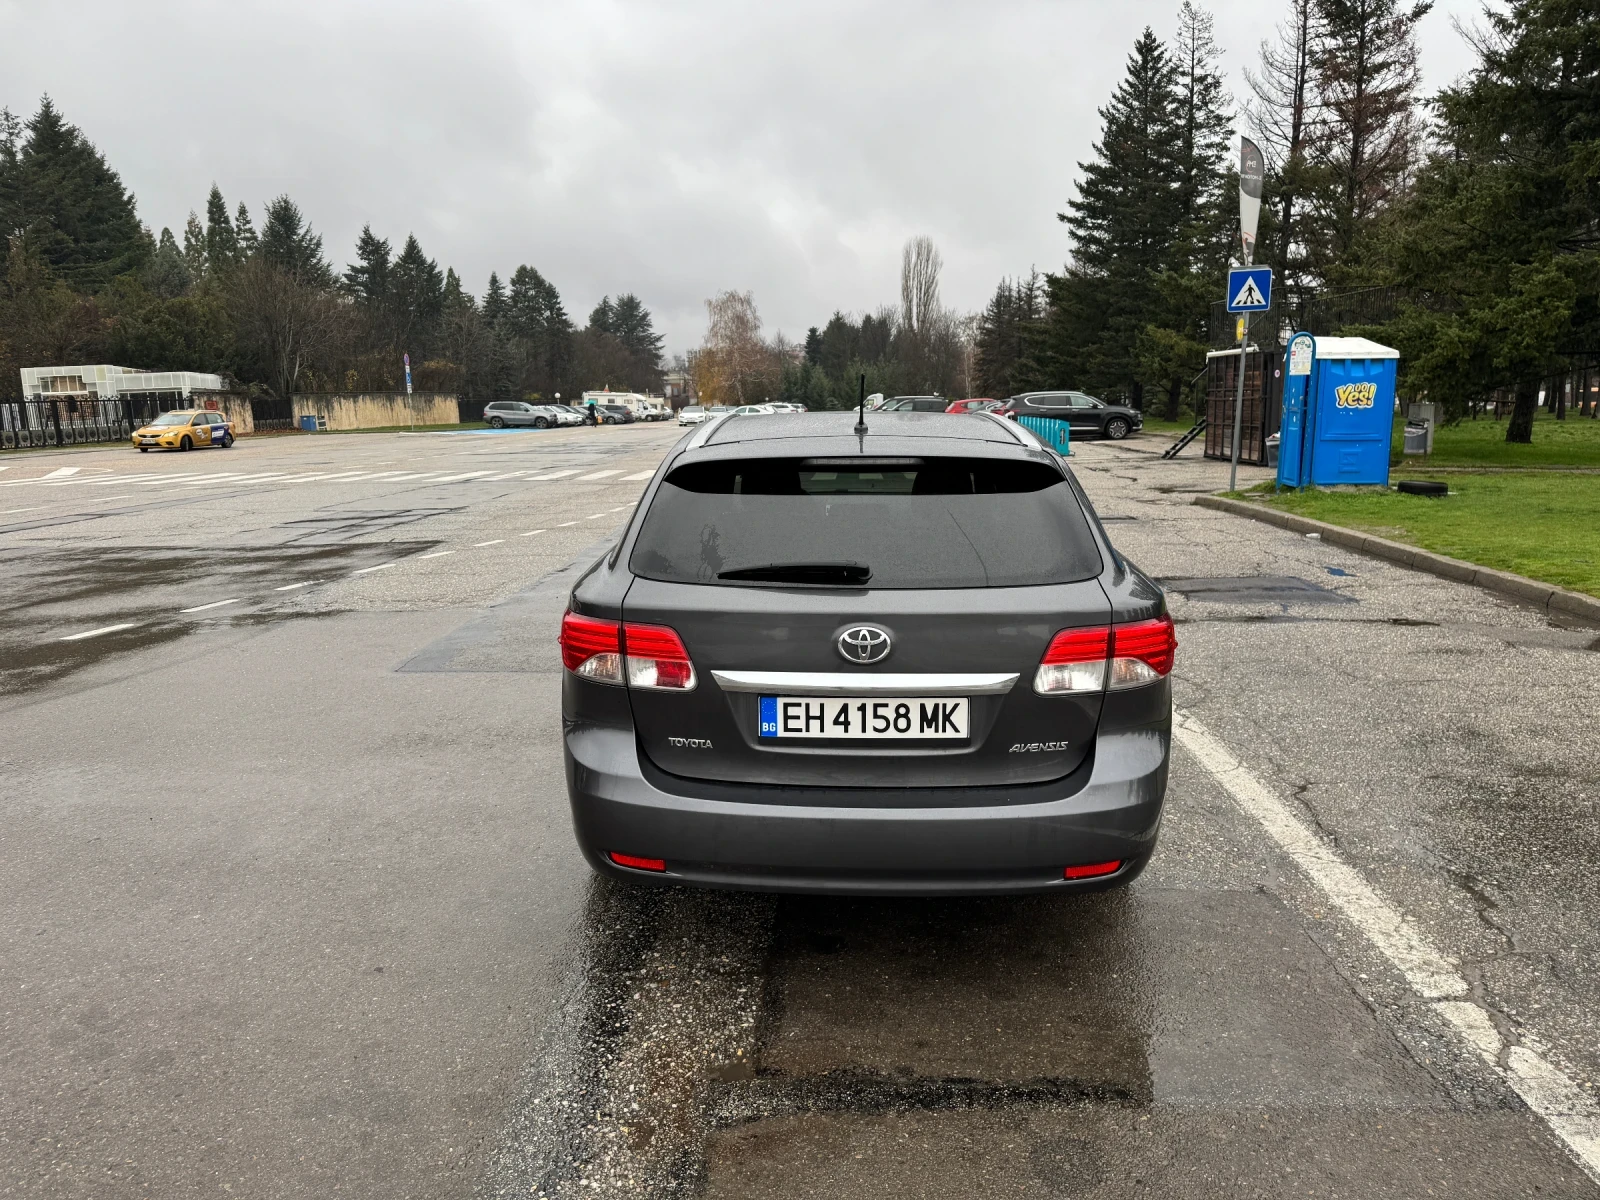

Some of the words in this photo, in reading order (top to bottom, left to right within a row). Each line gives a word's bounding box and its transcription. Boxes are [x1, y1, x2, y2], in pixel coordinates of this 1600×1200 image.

[783, 702, 825, 733] EH
[832, 702, 912, 734] 4158
[919, 702, 961, 734] MK
[762, 722, 777, 732] BG
[668, 737, 713, 749] TOYOTA
[1009, 741, 1068, 753] AVENSIS
